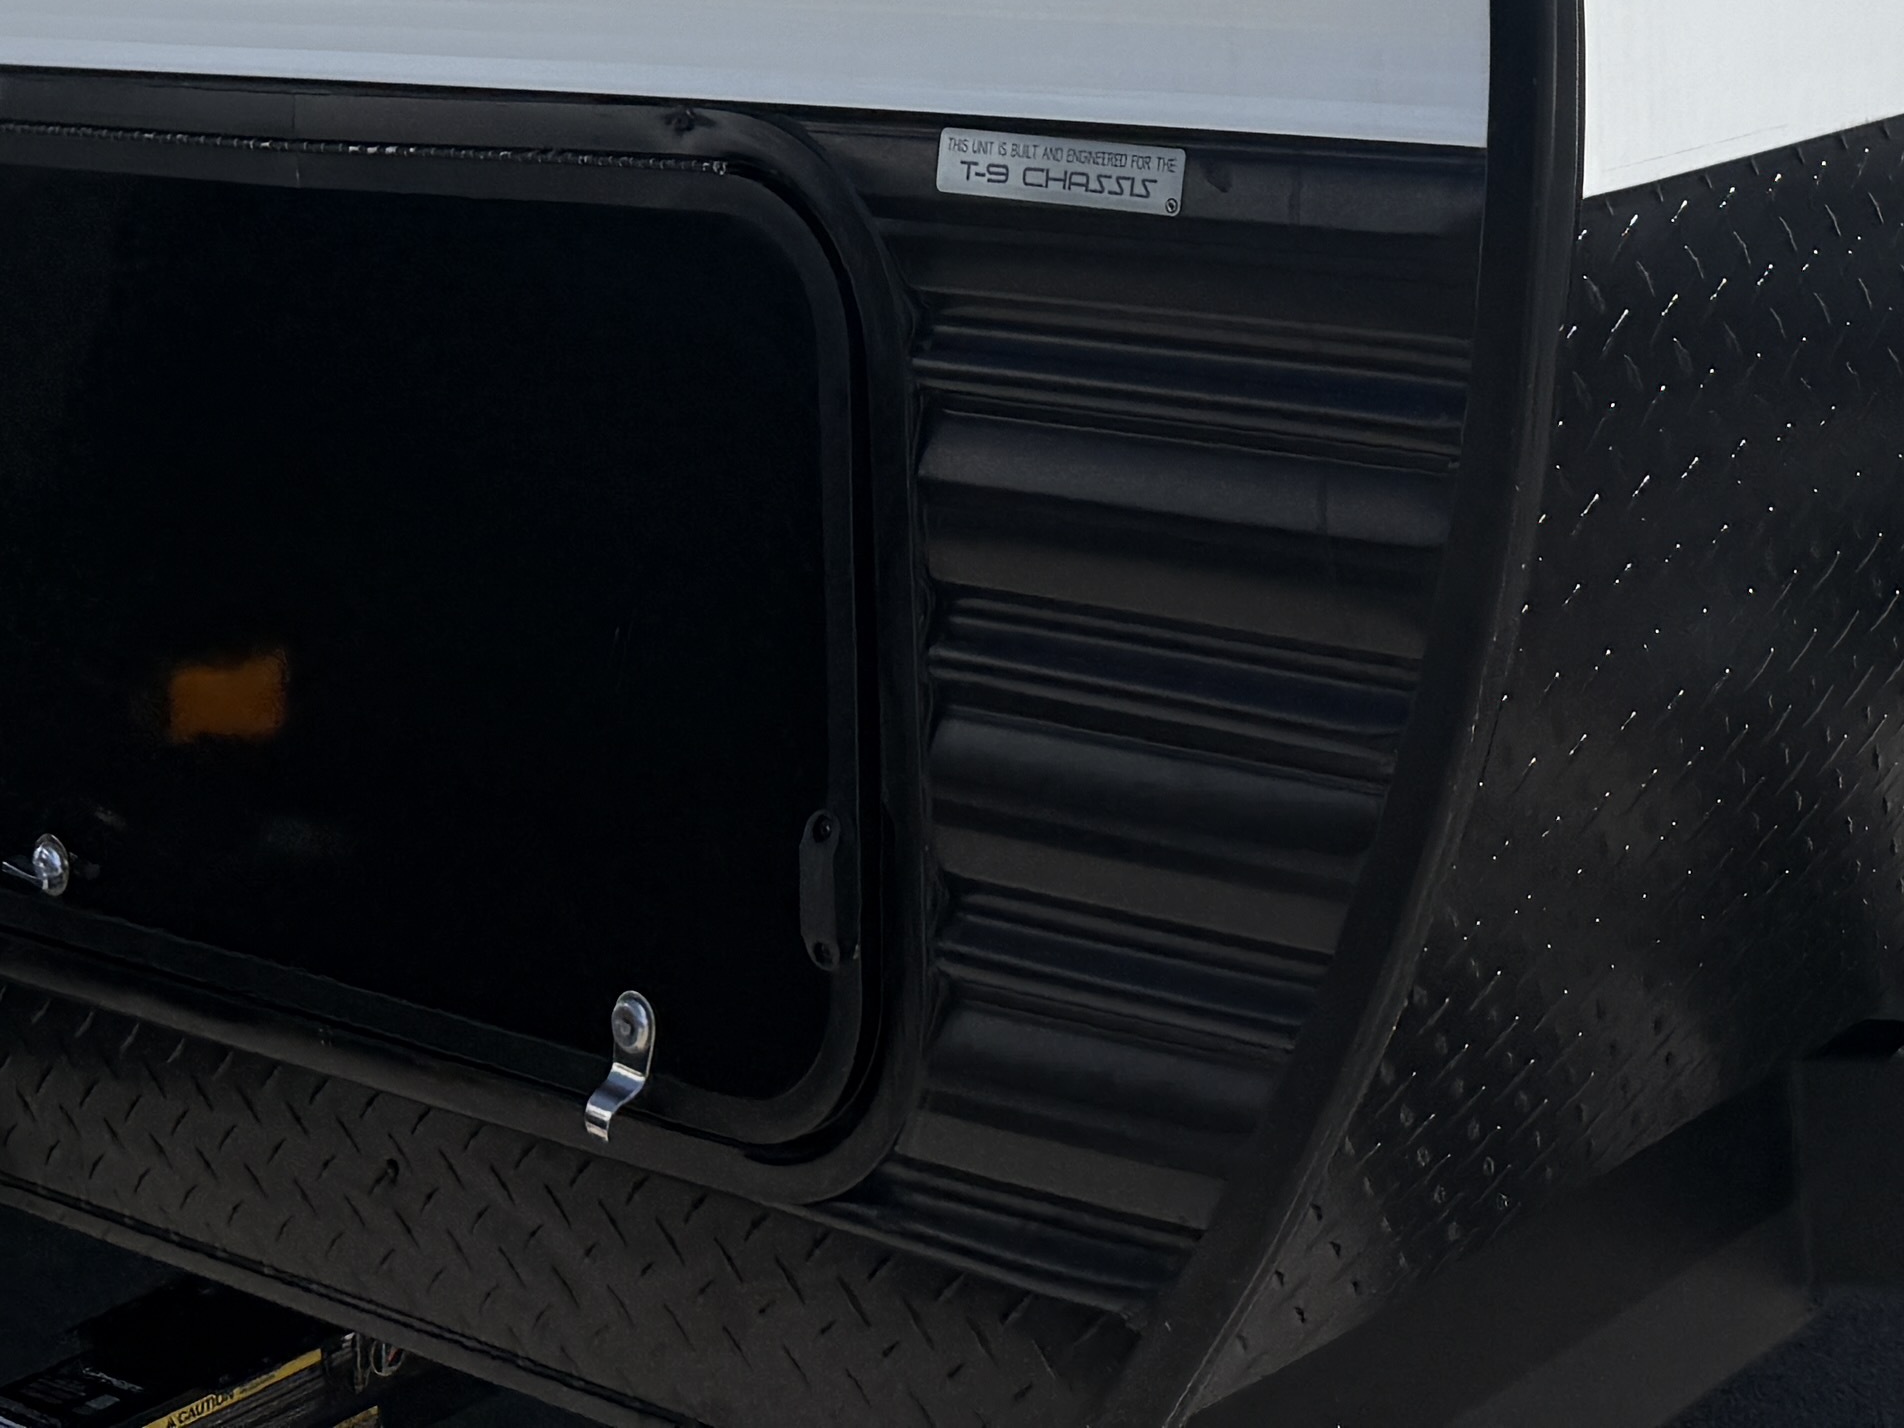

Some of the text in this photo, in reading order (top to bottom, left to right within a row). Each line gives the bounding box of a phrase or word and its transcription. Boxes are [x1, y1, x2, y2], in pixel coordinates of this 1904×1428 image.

[948, 137, 1178, 174] THIS UNIT IS BUILT AND ENGINEERED FOR THE
[960, 159, 1158, 199] T-9 CHASSIS
